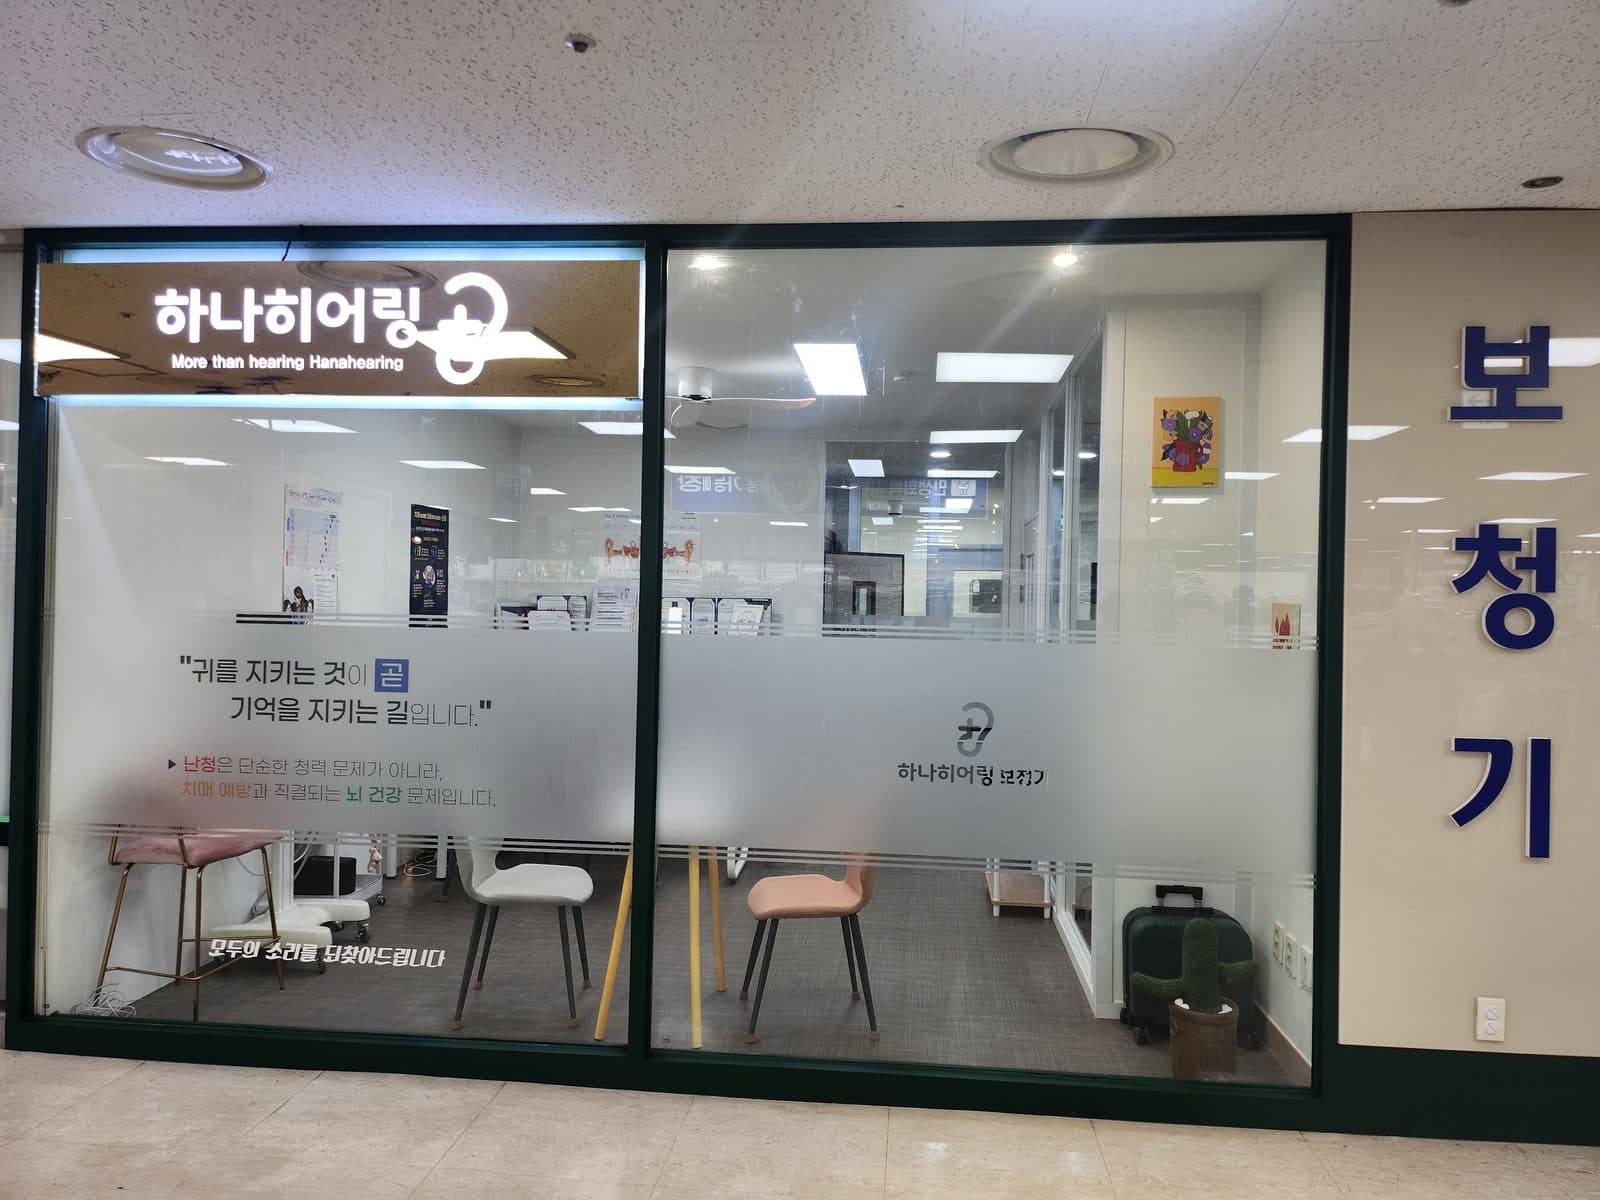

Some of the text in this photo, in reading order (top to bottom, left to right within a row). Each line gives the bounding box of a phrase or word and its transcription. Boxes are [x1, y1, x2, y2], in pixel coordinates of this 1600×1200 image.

[154, 287, 420, 349] 하나히어링
[171, 354, 404, 371] More than hearing Hanahearing
[1448, 325, 1563, 859] 보청기
[245, 660, 316, 686] 지키는
[323, 661, 367, 687] 것이
[379, 662, 405, 688] 곧
[231, 696, 301, 723] 기억을
[308, 698, 379, 725] 지키는
[184, 756, 233, 774] 난청은
[239, 757, 288, 775] 단순한
[294, 759, 326, 777] 청력
[332, 760, 384, 778] 문제가
[898, 763, 993, 786] 하나히어링
[182, 780, 214, 798] 치매
[219, 781, 269, 799] 예방과
[274, 783, 341, 801] 직결되는
[346, 786, 362, 803] 뇌
[369, 786, 402, 804] 건강
[208, 938, 447, 968] 모두의 소리를 되찾아드립니다
